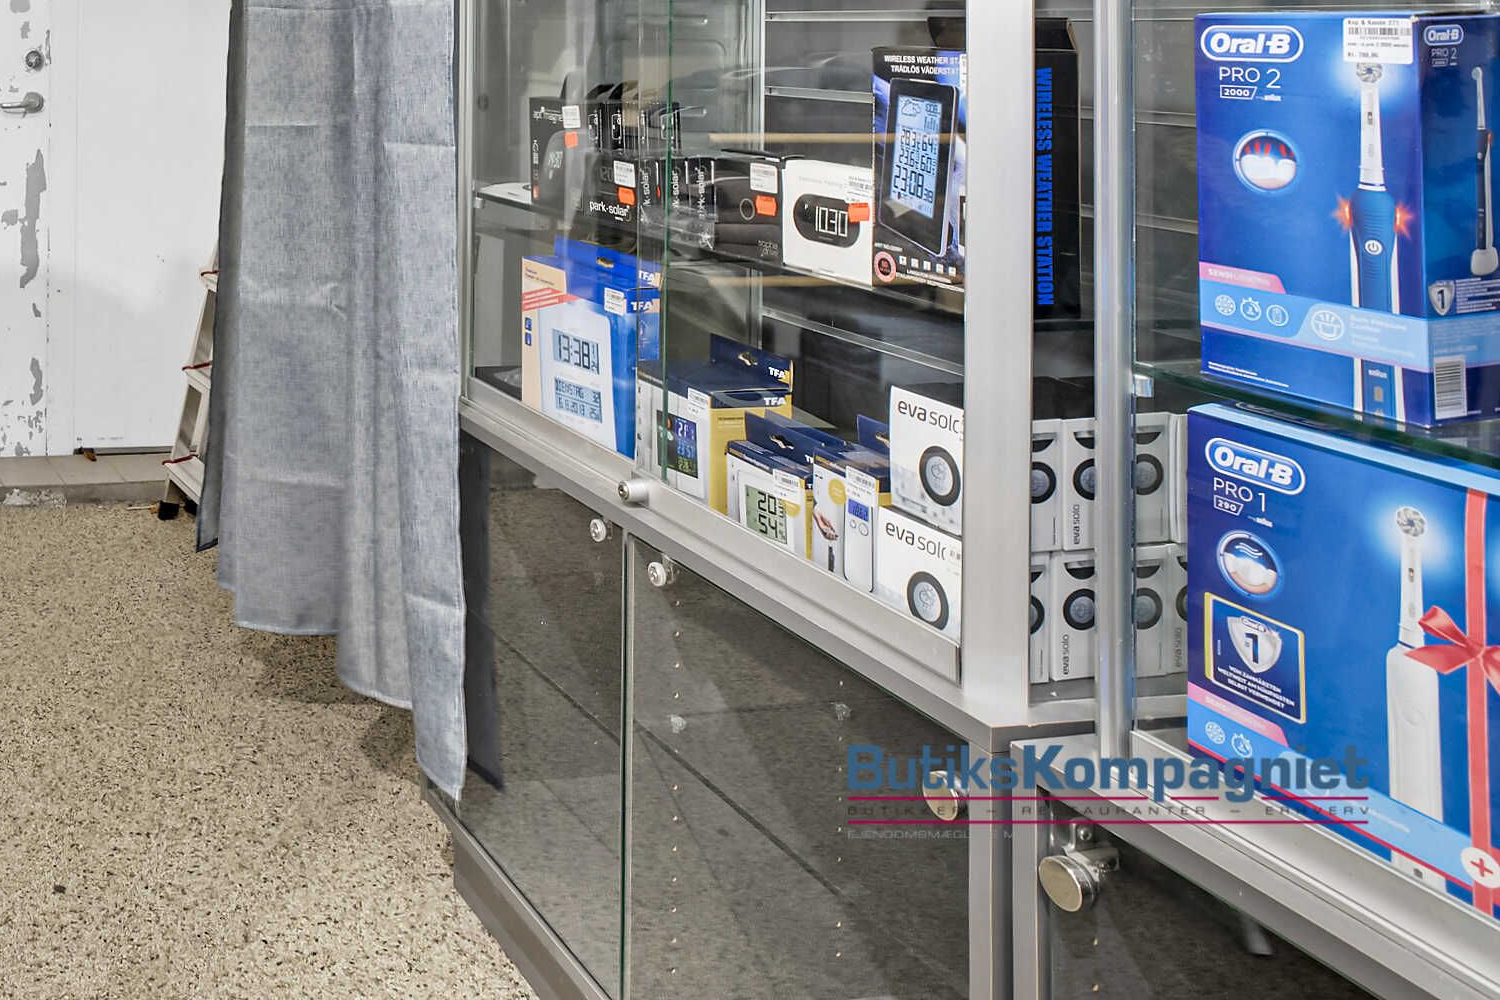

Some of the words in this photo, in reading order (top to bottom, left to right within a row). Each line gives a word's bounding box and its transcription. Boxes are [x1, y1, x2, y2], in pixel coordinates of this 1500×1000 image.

[1210, 32, 1291, 54] Oral-B
[1428, 29, 1460, 41] Oral-B
[884, 55, 916, 64] WIRELESS
[916, 56, 948, 65] WEATHER
[1431, 48, 1449, 57] PRO
[1451, 47, 1457, 59] 2
[1219, 66, 1260, 83] PRO
[1266, 68, 1281, 89] 2
[1223, 88, 1250, 97] 2000
[1036, 67, 1053, 151] WIRELESS
[1036, 153, 1053, 232] WEATHER
[639, 270, 656, 282] TFA
[1036, 235, 1054, 305] STATION
[631, 301, 654, 311] TFA
[1437, 289, 1445, 309] 1
[768, 367, 786, 379] TFA
[763, 397, 787, 406] TFA
[898, 400, 927, 422] eva
[1214, 446, 1294, 485] Oral-B
[1213, 477, 1253, 502] PRO
[1258, 492, 1266, 513] 1
[1217, 499, 1237, 512] 290
[885, 521, 915, 546] eva
[1245, 633, 1259, 664] 1
